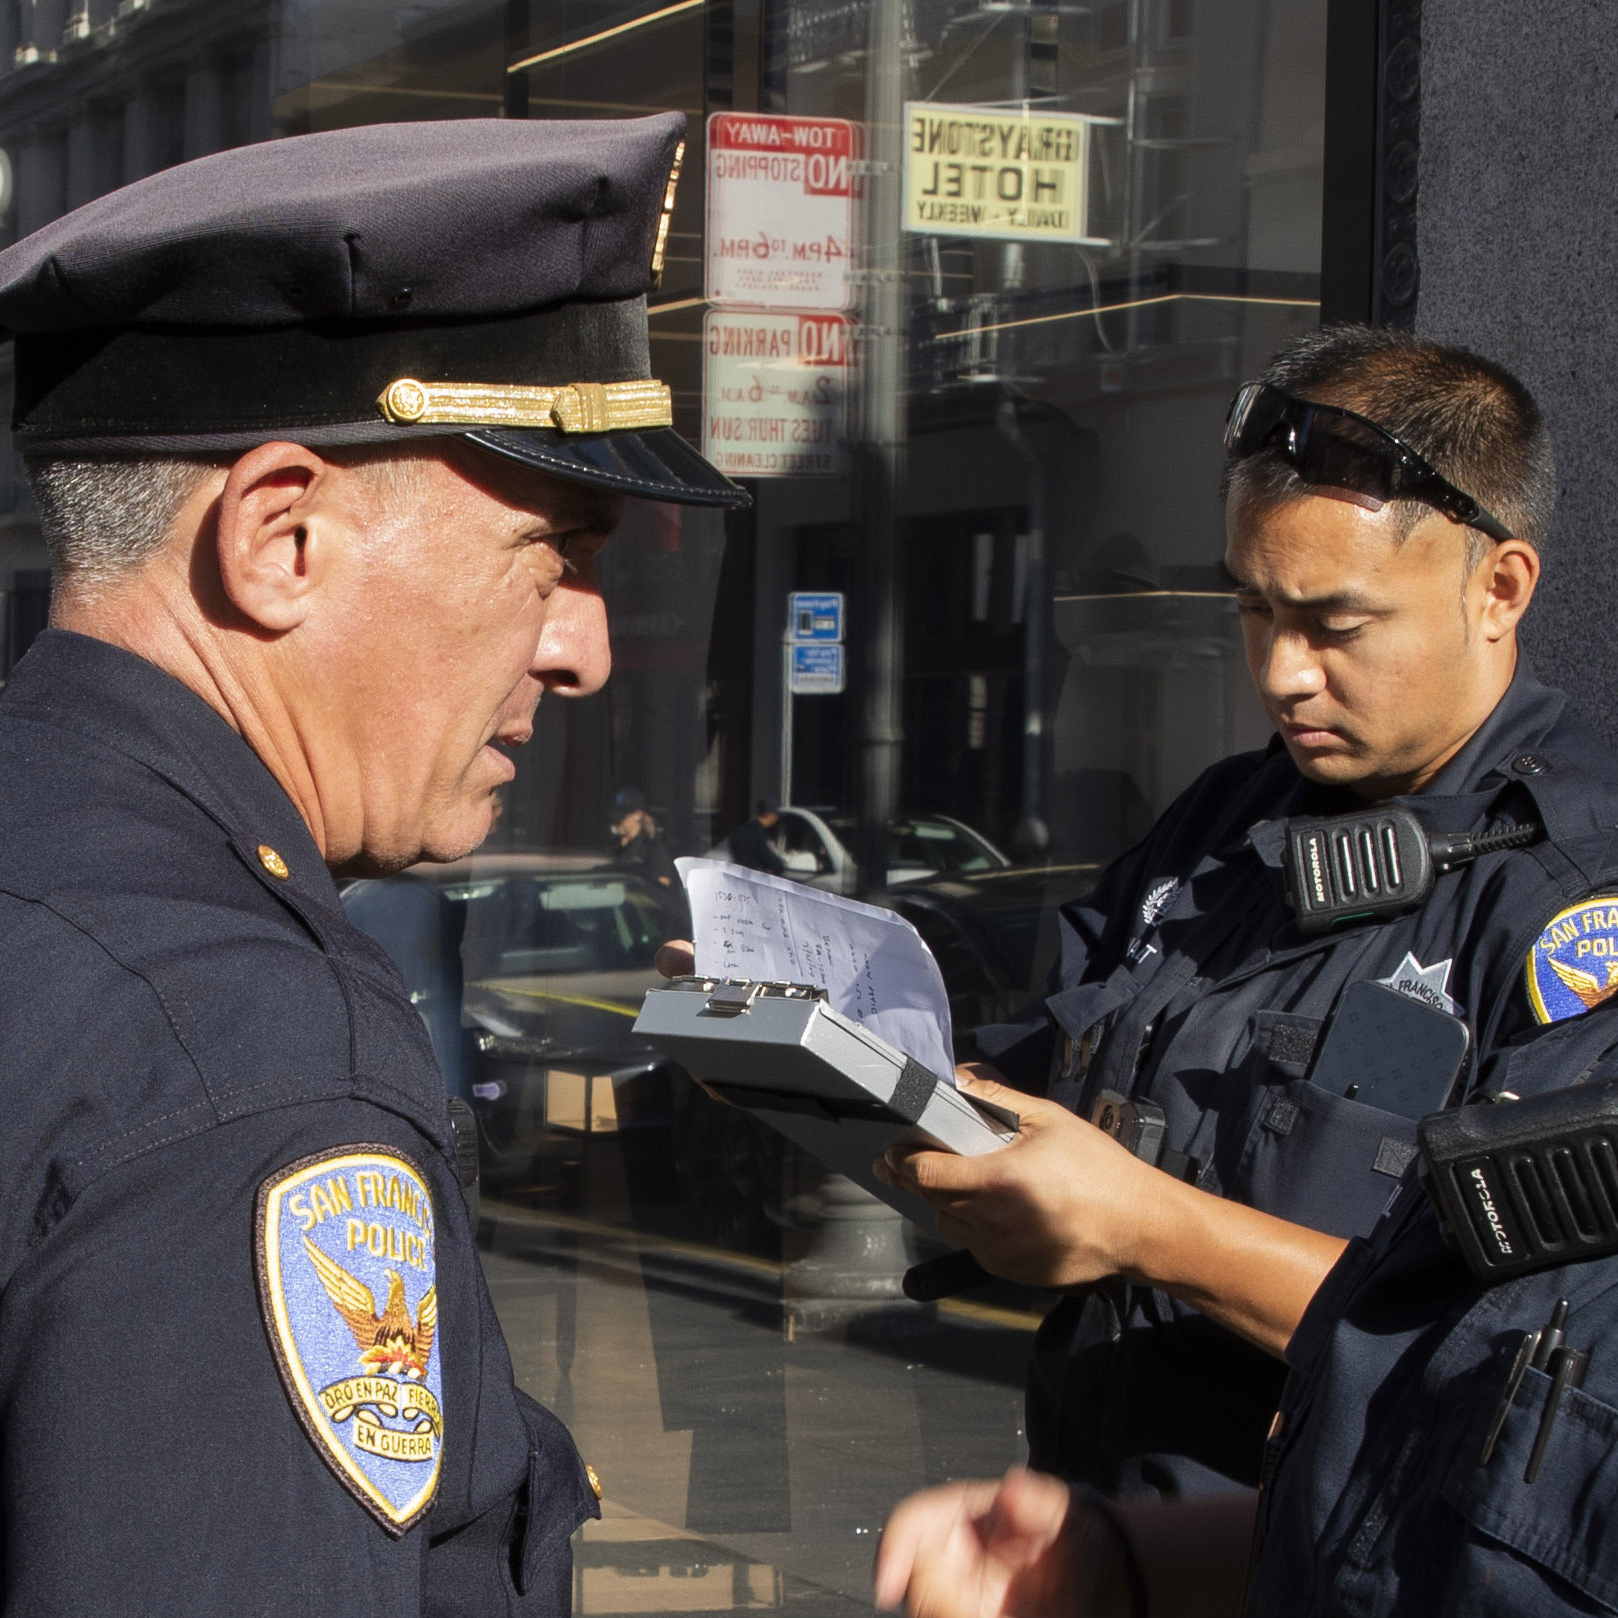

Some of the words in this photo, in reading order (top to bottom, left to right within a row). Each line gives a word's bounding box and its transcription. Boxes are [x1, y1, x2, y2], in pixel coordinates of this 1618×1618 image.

[1309, 838, 1325, 902] MOTOROLA
[1539, 918, 1580, 955] SAN
[288, 1176, 353, 1232] SAN
[347, 1218, 426, 1271] POLICE
[325, 1384, 354, 1409] ORO
[356, 1382, 372, 1399] EN
[375, 1381, 399, 1402] PAZ
[357, 1424, 376, 1447] EN
[381, 1434, 431, 1456] GUERRA
